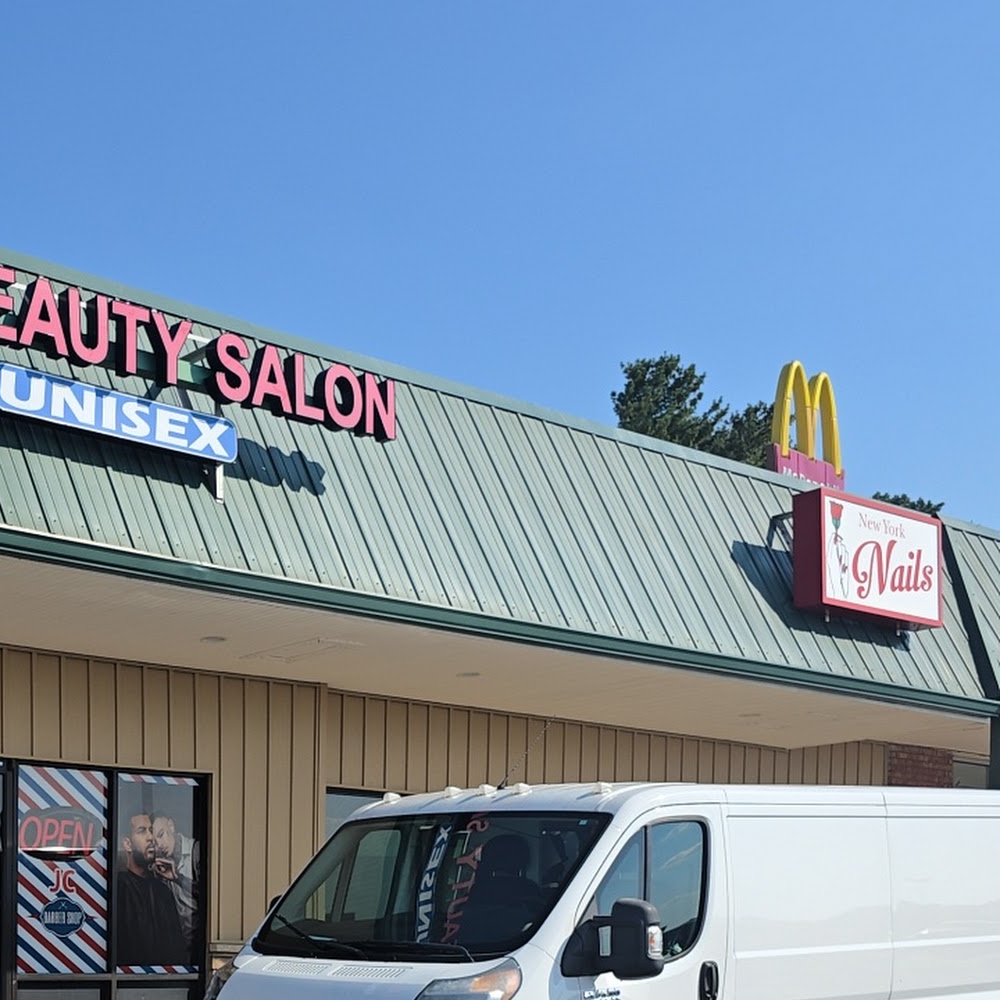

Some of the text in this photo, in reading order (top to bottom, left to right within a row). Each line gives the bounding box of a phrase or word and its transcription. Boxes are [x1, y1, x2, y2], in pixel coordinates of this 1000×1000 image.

[208, 332, 398, 442] SALON
[859, 512, 906, 539] New York
[852, 539, 934, 599] Nails
[18, 815, 94, 857] OPEN
[49, 868, 76, 893] JC
